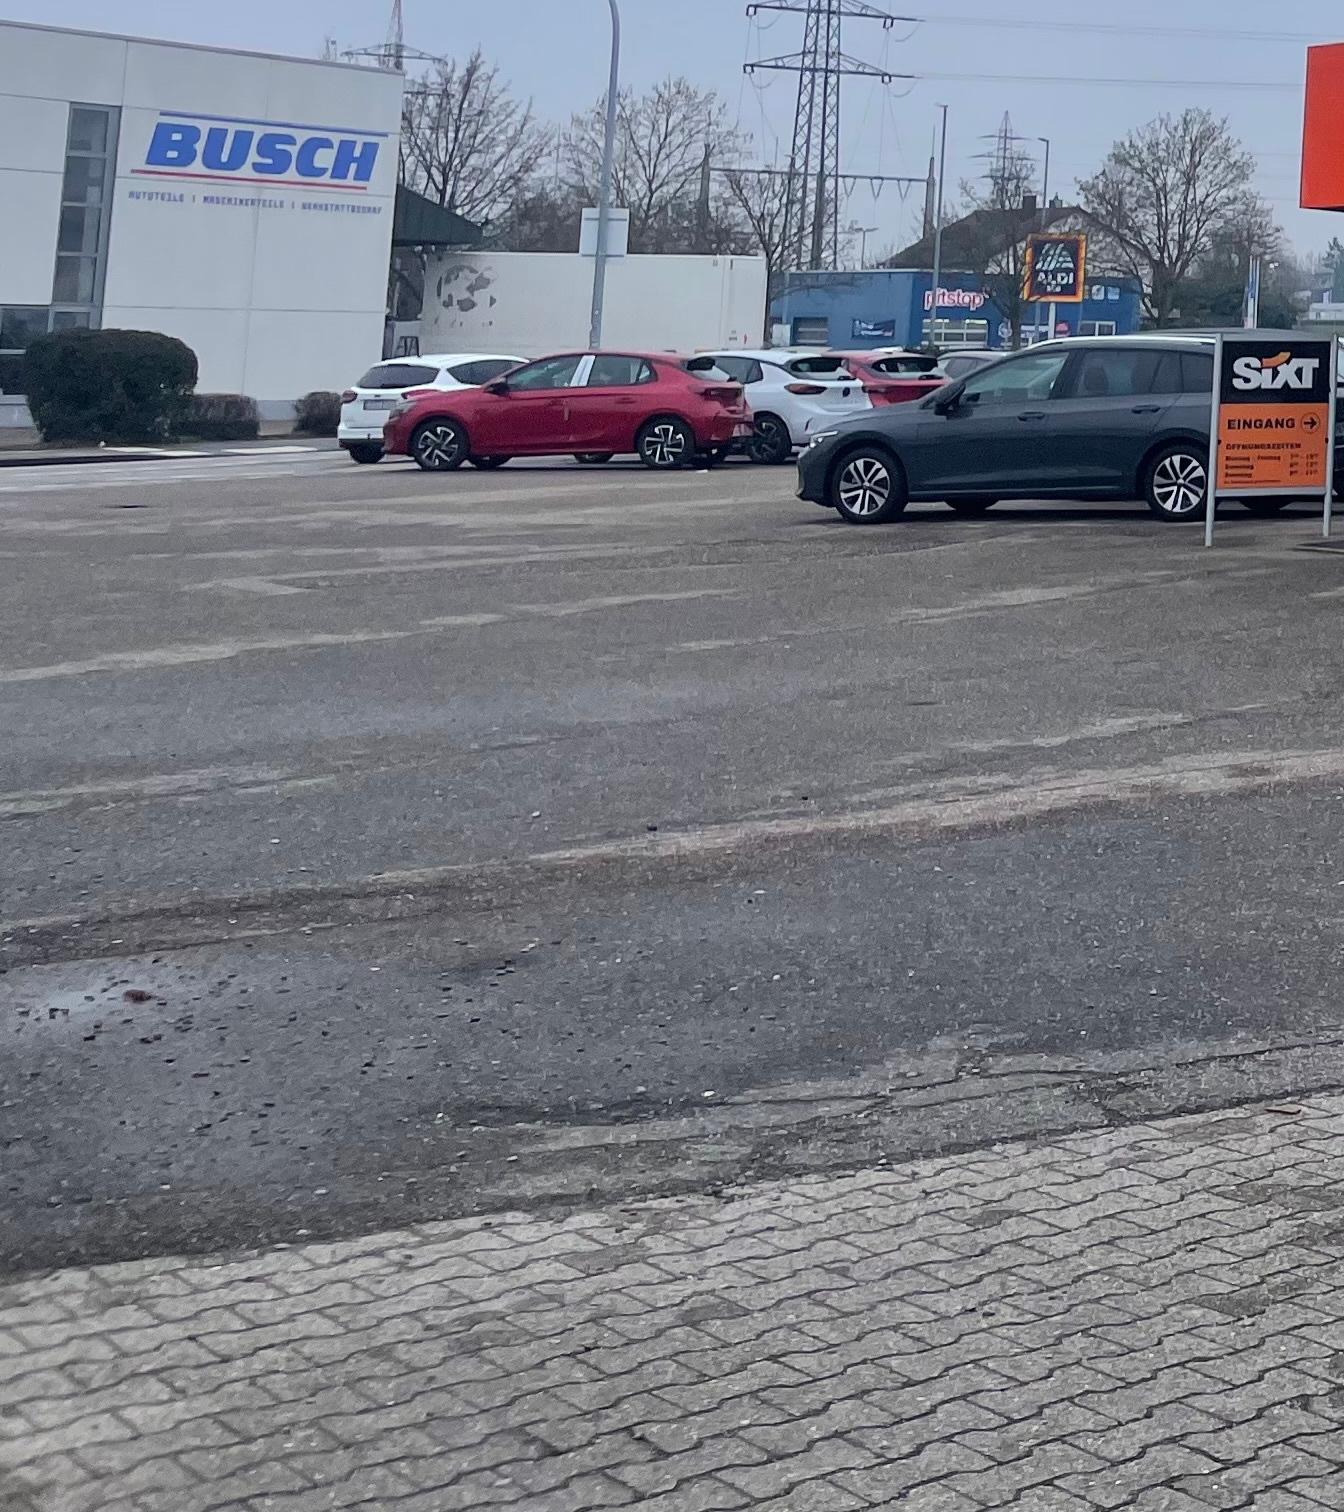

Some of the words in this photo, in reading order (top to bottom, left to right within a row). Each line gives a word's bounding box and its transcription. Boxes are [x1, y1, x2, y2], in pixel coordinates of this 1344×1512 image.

[145, 122, 379, 182] BUSCH
[1038, 272, 1073, 285] ALDI
[1227, 418, 1296, 430] EINGANG
